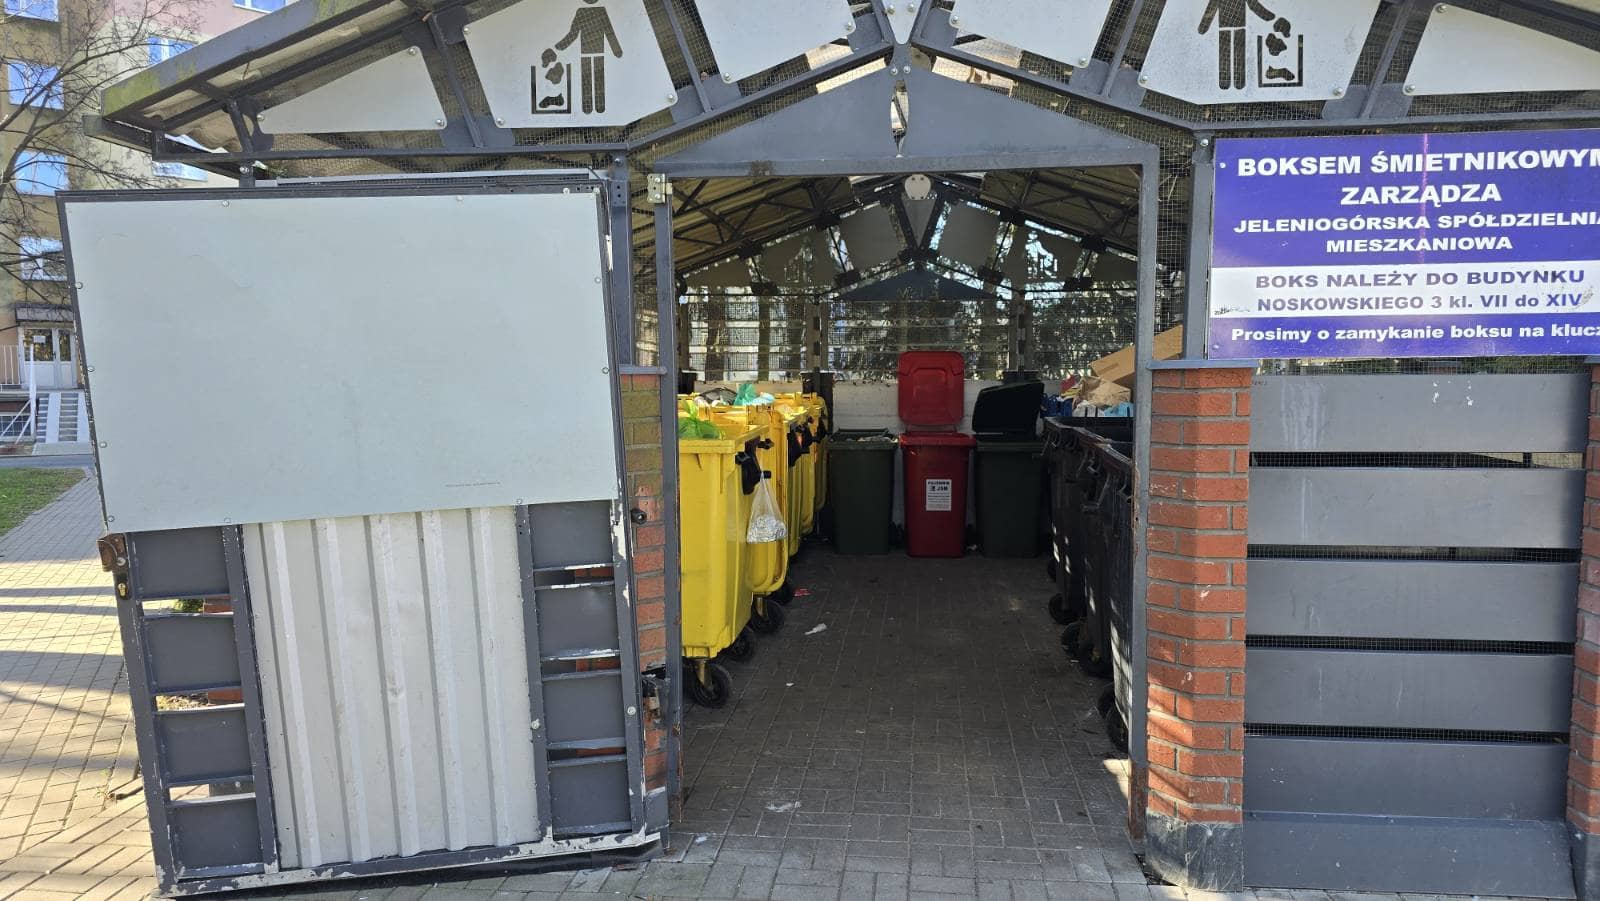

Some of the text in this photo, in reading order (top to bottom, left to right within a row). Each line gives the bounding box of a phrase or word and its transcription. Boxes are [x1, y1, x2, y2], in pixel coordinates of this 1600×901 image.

[1238, 156, 1361, 176] BOKSEM
[1340, 183, 1502, 207] ZARZĄDZA
[1233, 214, 1430, 233] JELENIOGÓRSKA
[1326, 236, 1513, 253] MIESZKANIOWA
[1256, 269, 1585, 288] BOKS NALEŻY DO BUDYNKU
[1257, 296, 1424, 312] NOSKOWSKIEGO
[1430, 295, 1442, 309] 3
[1449, 295, 1473, 308] kl.
[1480, 294, 1507, 307] VII
[1515, 294, 1539, 307] do
[1545, 293, 1582, 307] XIV
[1231, 327, 1311, 343] Prosimy
[1317, 330, 1330, 340] o
[1335, 326, 1444, 342] zamykanie
[1450, 325, 1512, 338] boksu
[1519, 325, 1544, 337] na
